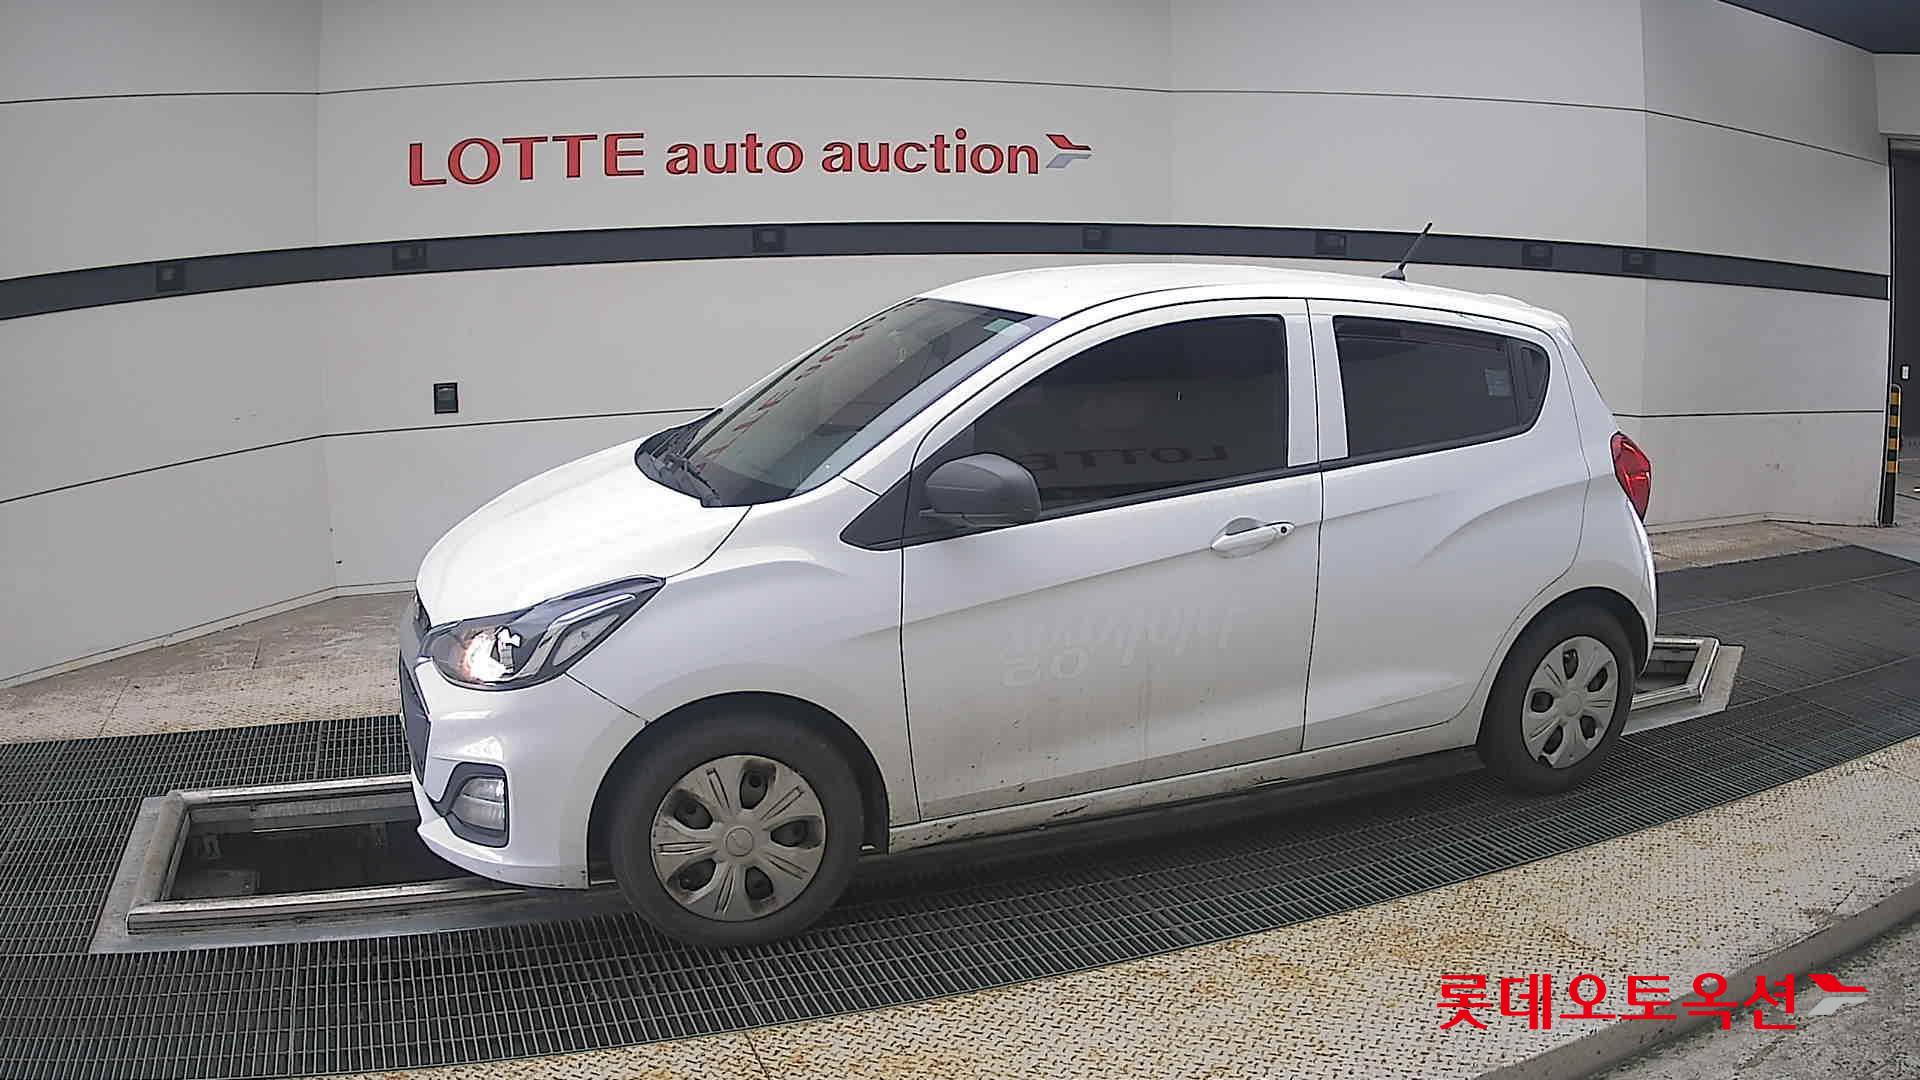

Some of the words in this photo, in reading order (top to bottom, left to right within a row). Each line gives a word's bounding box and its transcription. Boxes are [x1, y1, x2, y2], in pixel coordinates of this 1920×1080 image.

[408, 131, 645, 187] LOTTE
[665, 132, 804, 175] auto
[821, 128, 1040, 175] auction
